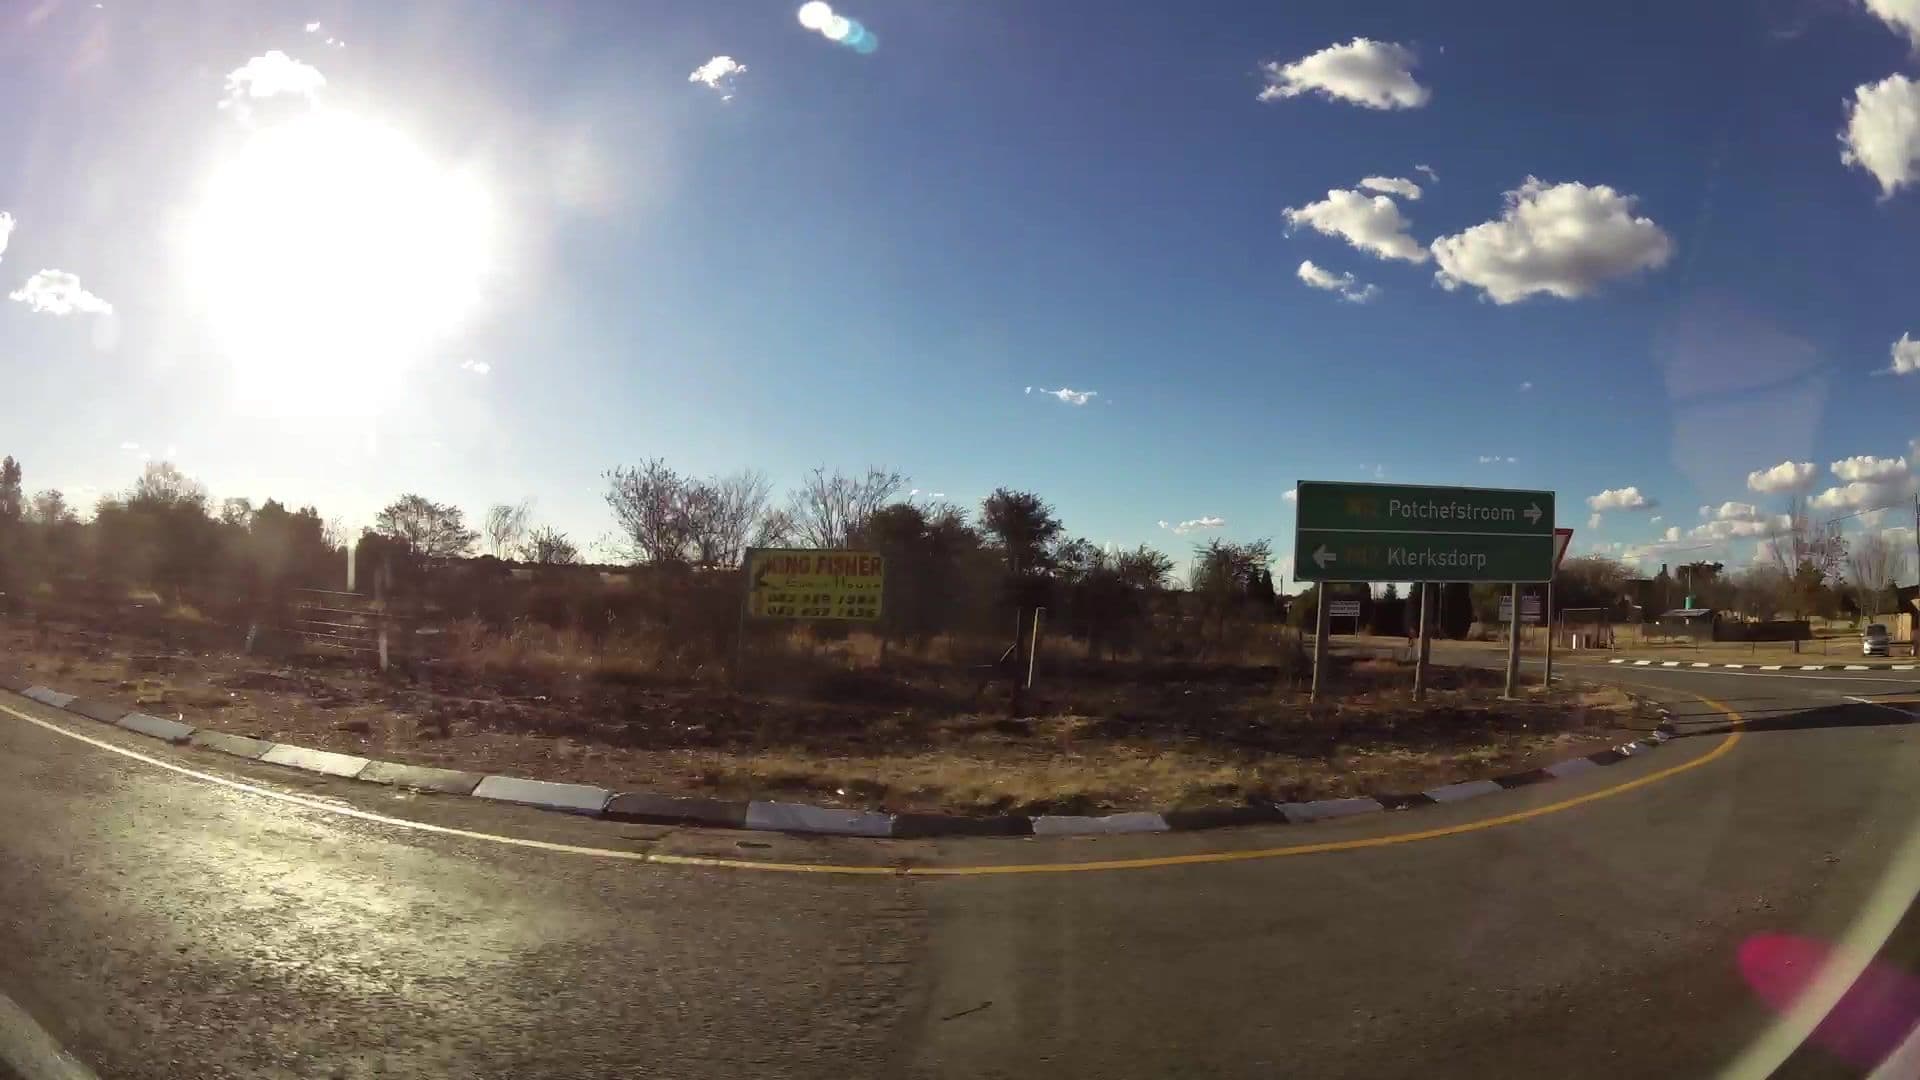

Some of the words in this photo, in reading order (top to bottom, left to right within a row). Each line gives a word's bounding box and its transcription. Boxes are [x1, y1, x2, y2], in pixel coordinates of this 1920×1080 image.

[1389, 499, 1516, 521] Potchefstroom
[816, 555, 882, 577] FISHER
[1387, 547, 1487, 570] Klerksdorp
